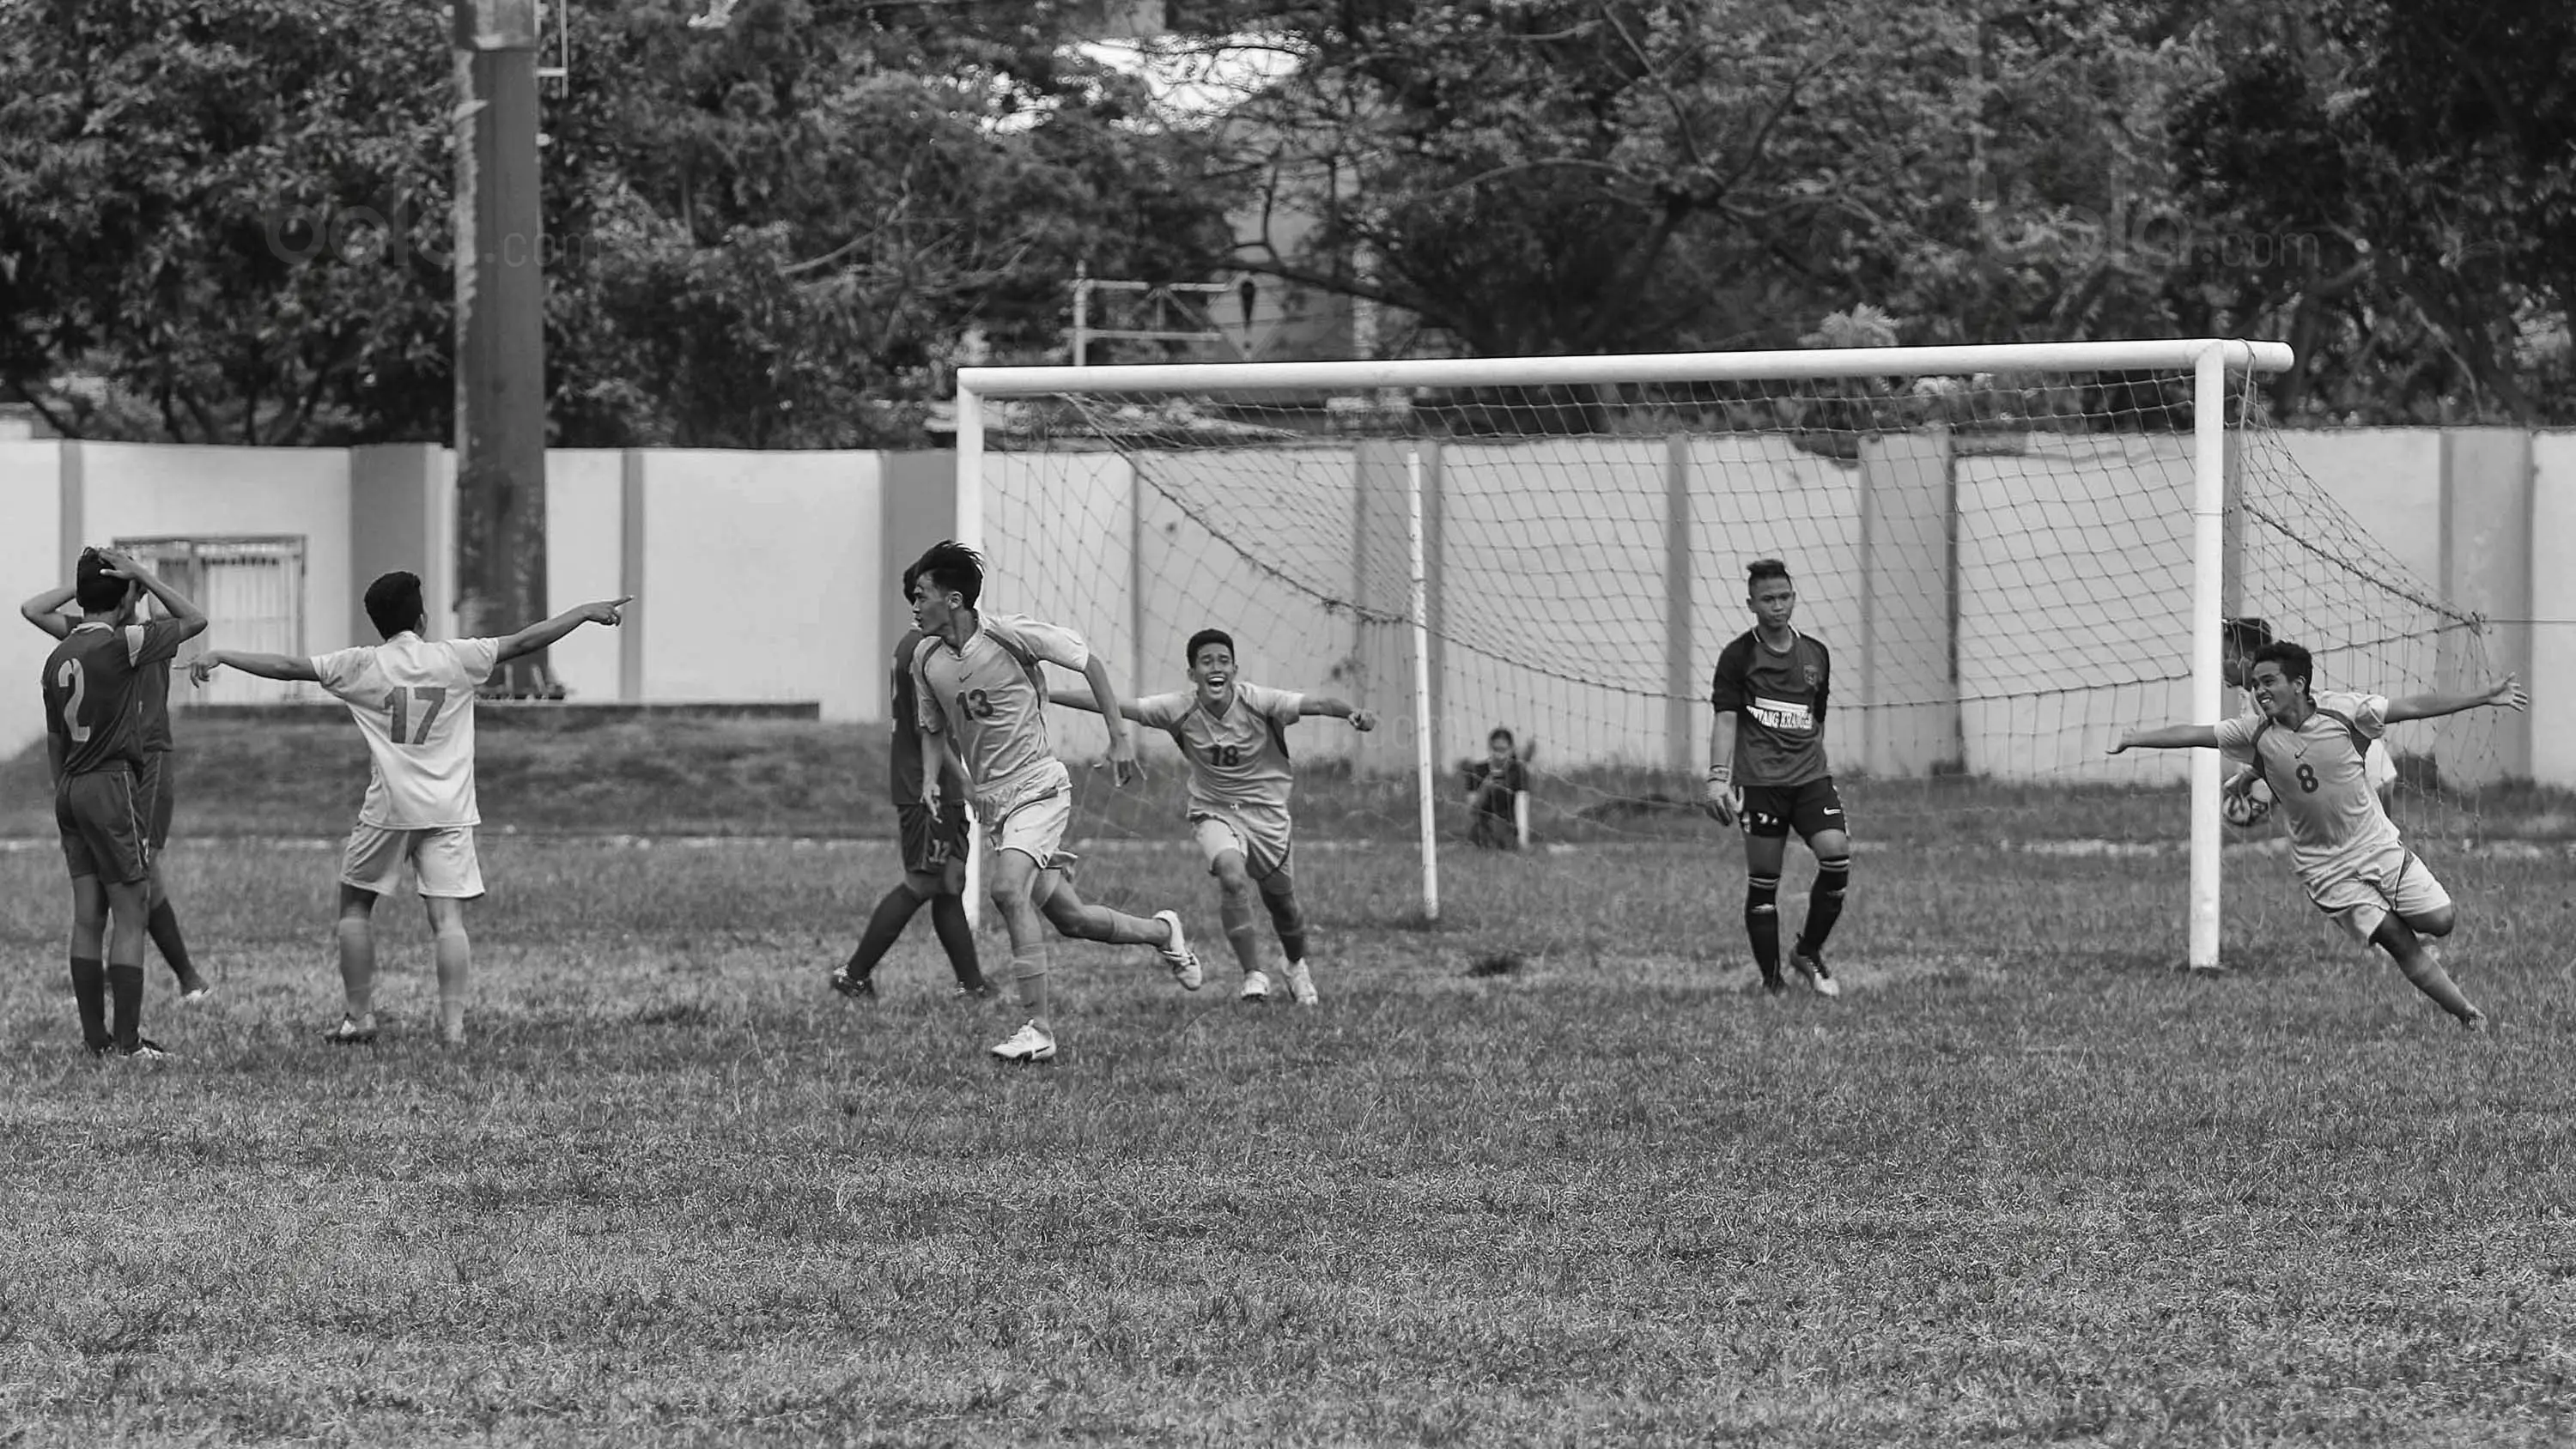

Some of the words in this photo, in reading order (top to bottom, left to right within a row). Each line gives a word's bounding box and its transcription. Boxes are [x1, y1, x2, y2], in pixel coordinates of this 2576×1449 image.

[58, 658, 91, 743] 2
[384, 686, 447, 745] 17
[956, 688, 993, 721] 13
[1209, 744, 1238, 767] 18
[2296, 763, 2319, 793] 8
